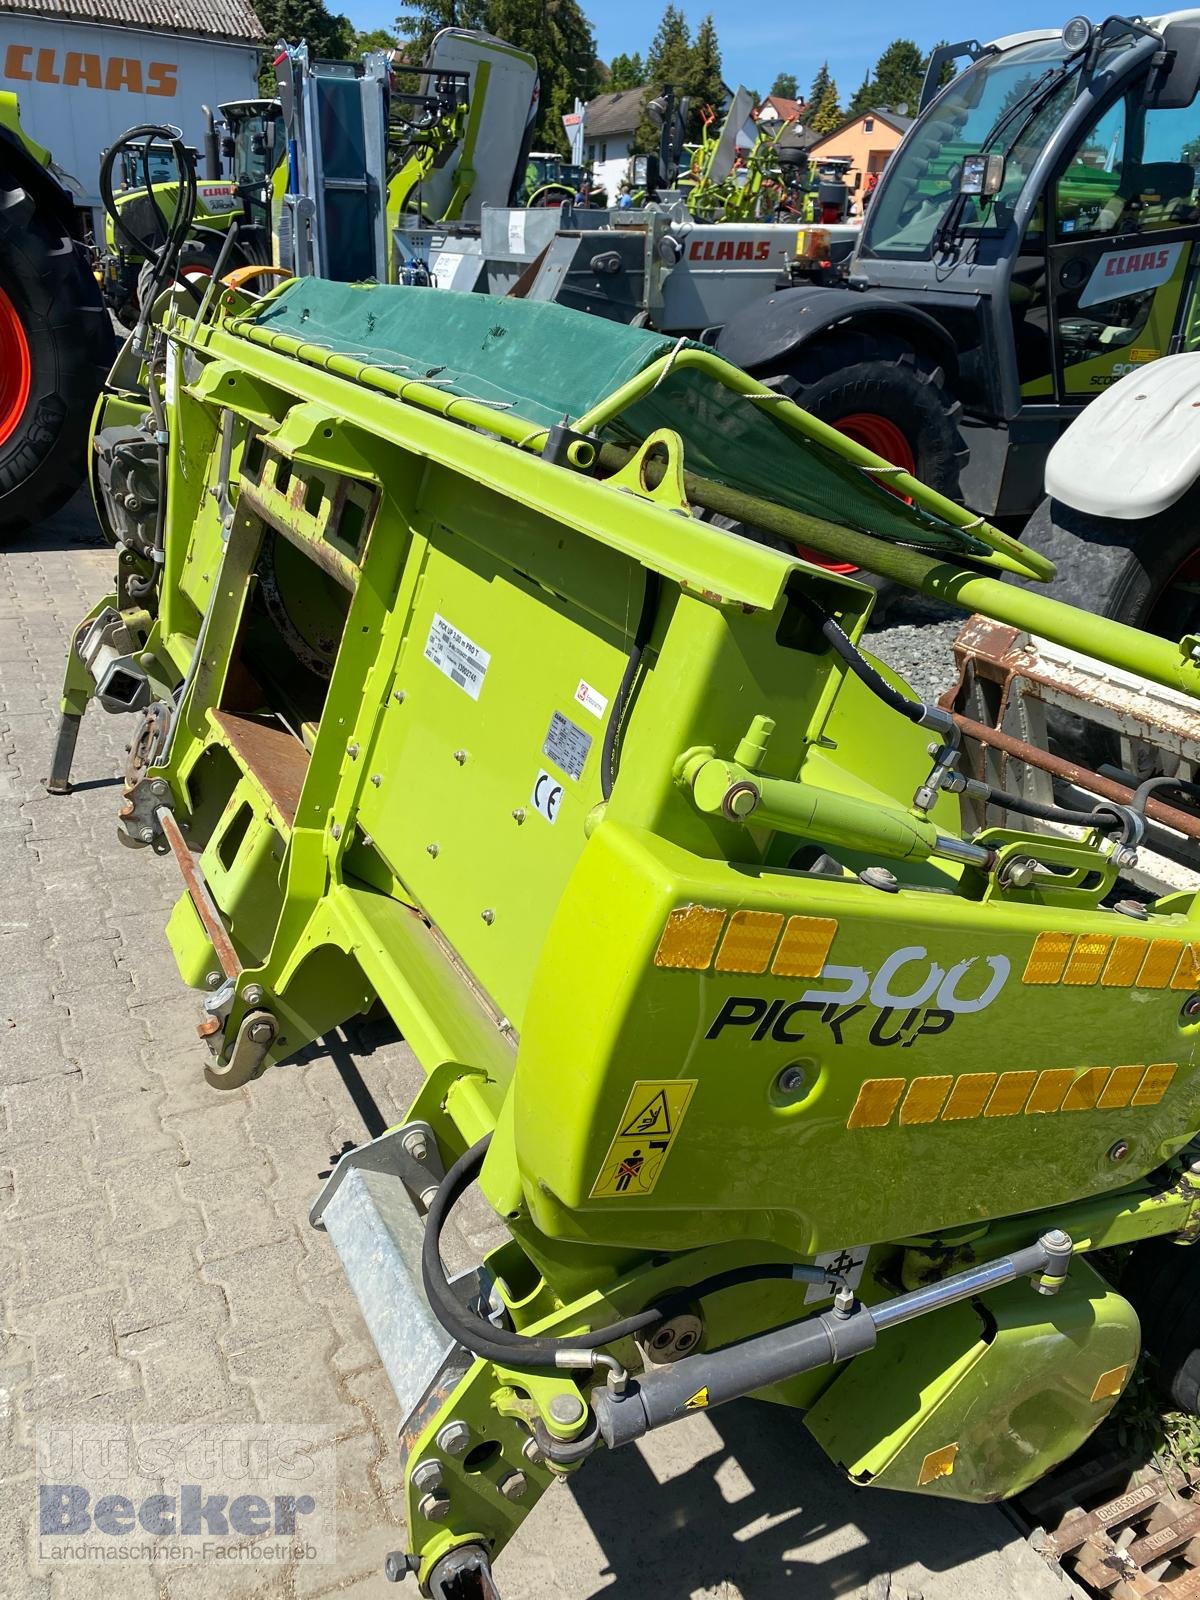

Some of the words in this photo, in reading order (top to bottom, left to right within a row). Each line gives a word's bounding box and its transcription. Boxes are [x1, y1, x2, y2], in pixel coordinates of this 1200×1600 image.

[4, 44, 178, 97] CLAAS
[203, 187, 231, 197] CLAA
[689, 241, 771, 261] CLAAS
[1104, 250, 1169, 277] CLAAS
[704, 996, 867, 1045] PICK
[868, 1005, 956, 1048] UP
